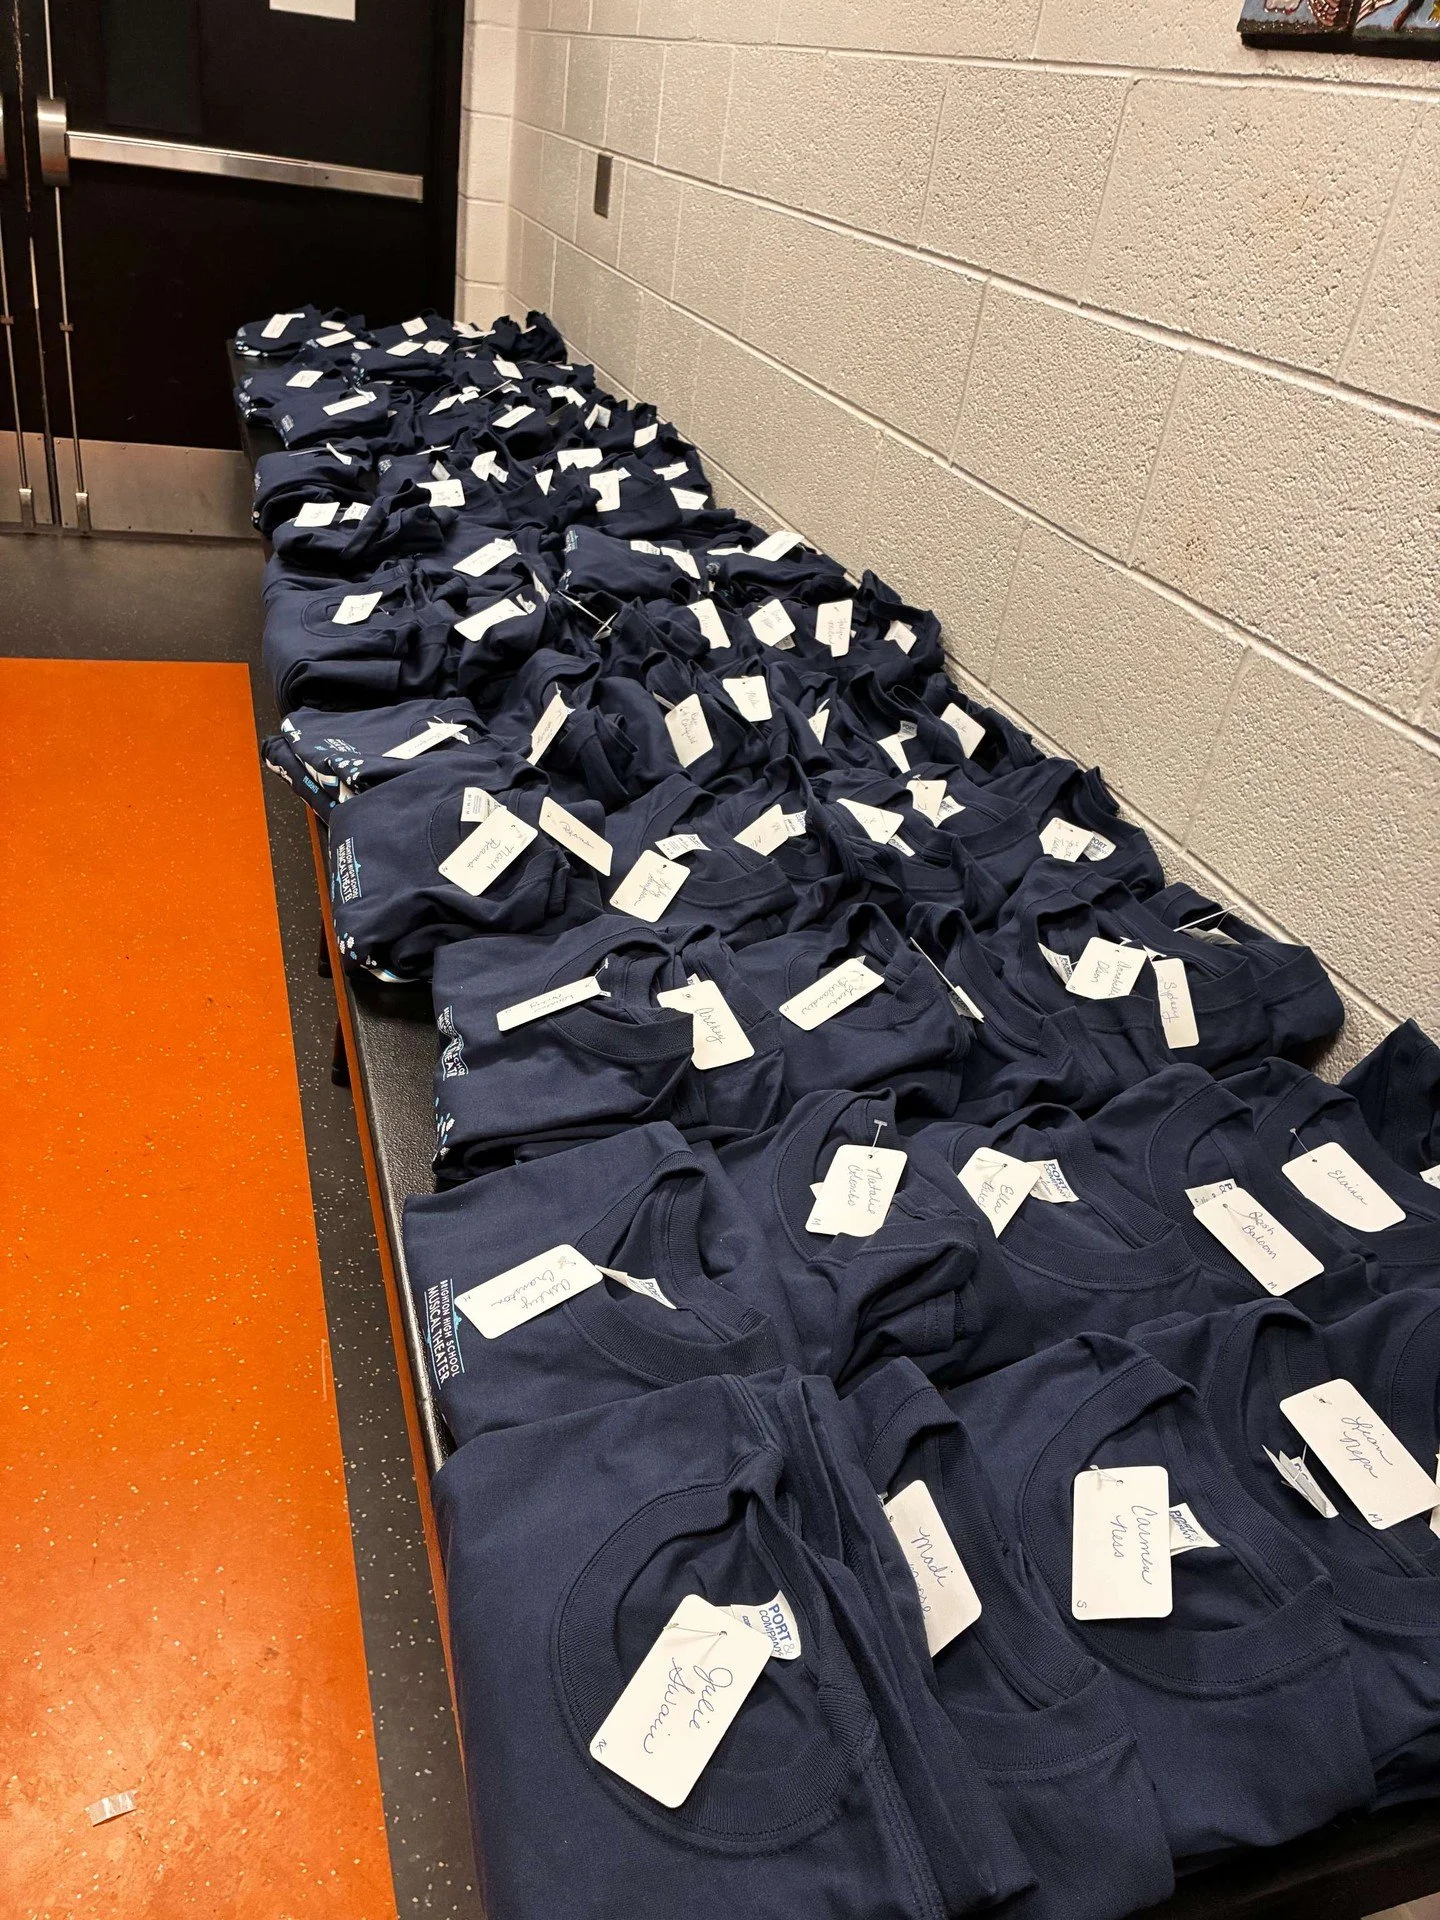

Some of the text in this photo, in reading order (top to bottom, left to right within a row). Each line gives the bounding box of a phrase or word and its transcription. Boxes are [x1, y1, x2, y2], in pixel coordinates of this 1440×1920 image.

[1048, 1163, 1071, 1192] PORT
[427, 1285, 450, 1384] MUSICAL THEATER
[440, 1280, 460, 1377] BRIGHTON HIGH SCHOOL
[769, 1603, 792, 1641] PORT
[688, 1665, 733, 1729] Julie
